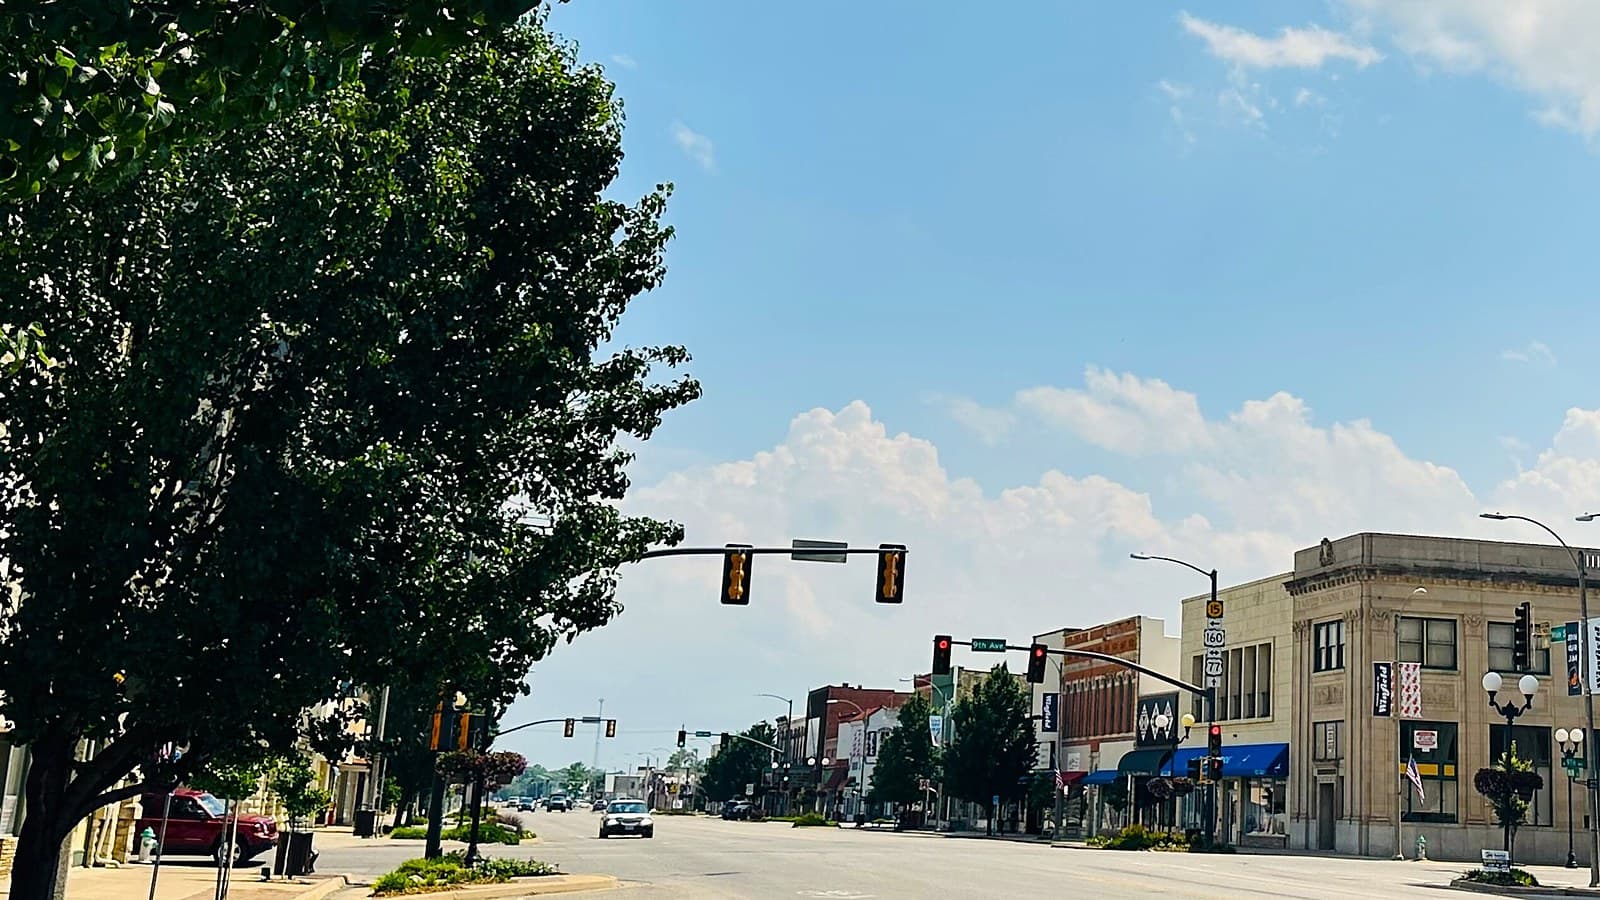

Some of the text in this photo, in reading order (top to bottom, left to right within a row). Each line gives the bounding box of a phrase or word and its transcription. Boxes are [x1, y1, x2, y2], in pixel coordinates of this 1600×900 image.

[1210, 604, 1220, 614] 15
[1206, 633, 1223, 643] 160
[972, 641, 987, 649] 9th
[1208, 662, 1220, 672] 77
[1379, 665, 1390, 713] Winfield
